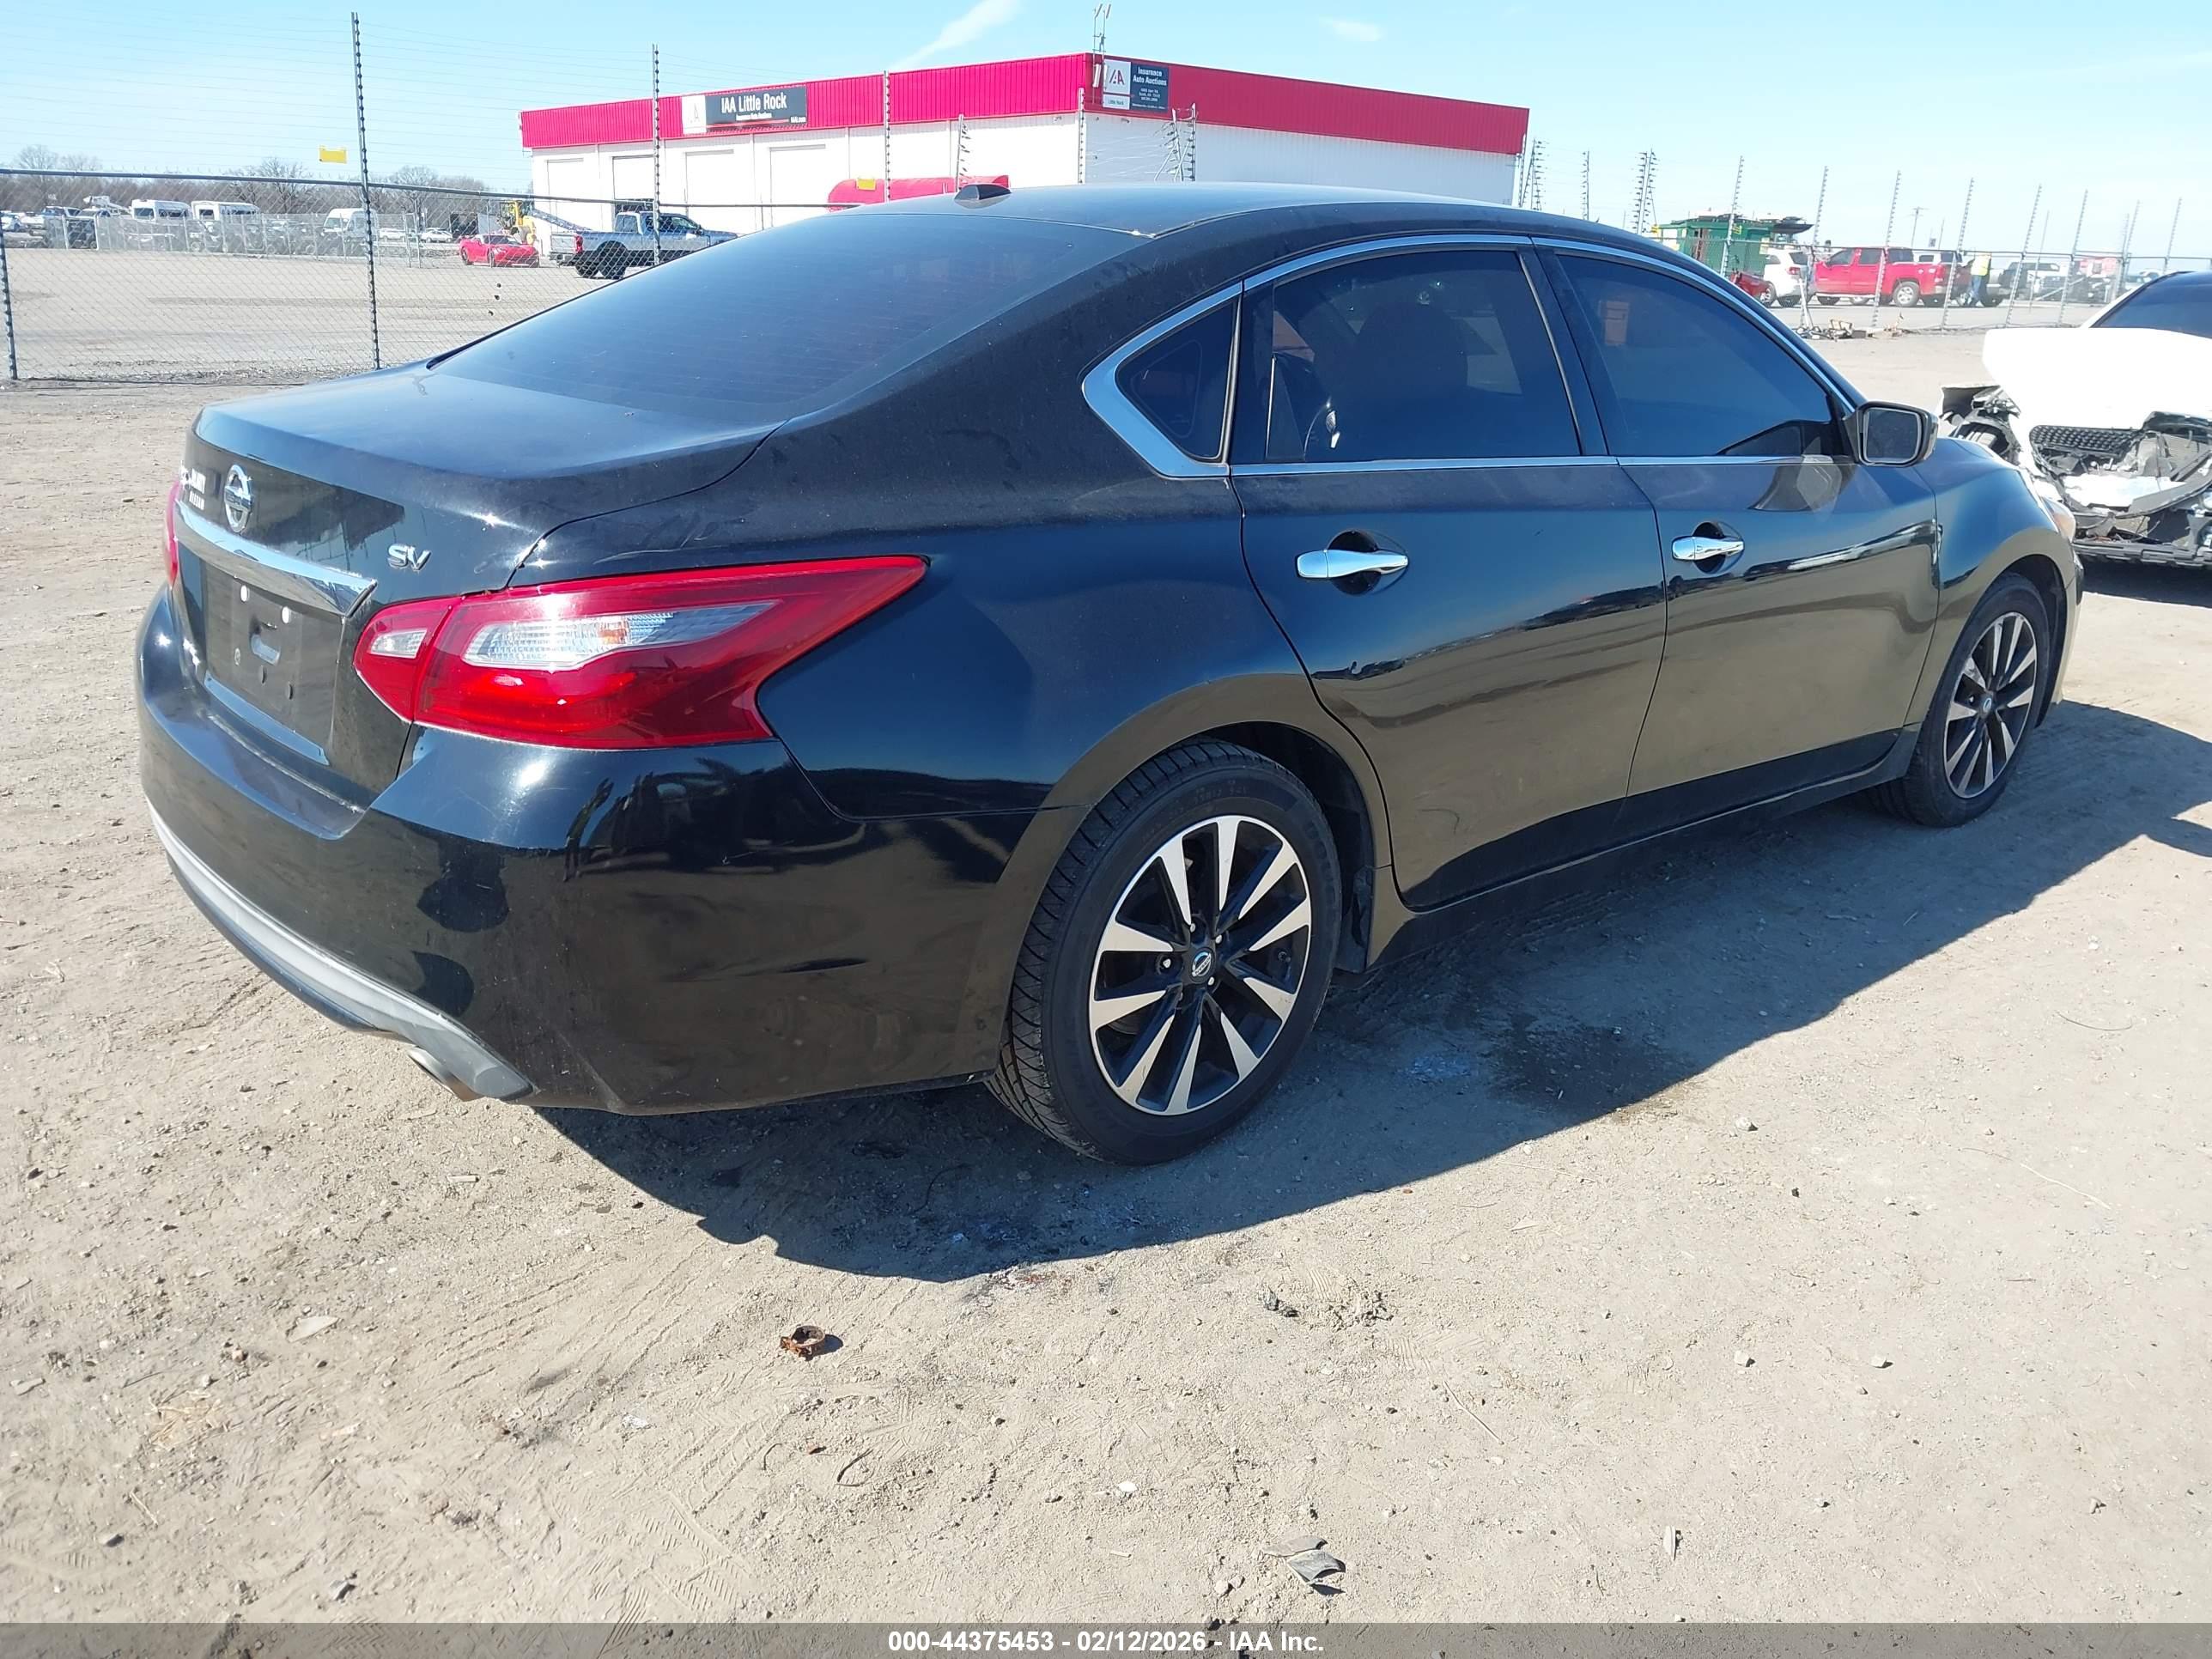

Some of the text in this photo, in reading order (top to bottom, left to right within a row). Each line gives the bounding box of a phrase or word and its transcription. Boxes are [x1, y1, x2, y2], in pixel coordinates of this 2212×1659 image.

[1138, 66, 1163, 76] Insurance
[1133, 75, 1167, 86] Auto Auctions
[721, 92, 787, 113] IAA Little Rock
[388, 544, 431, 571] SV
